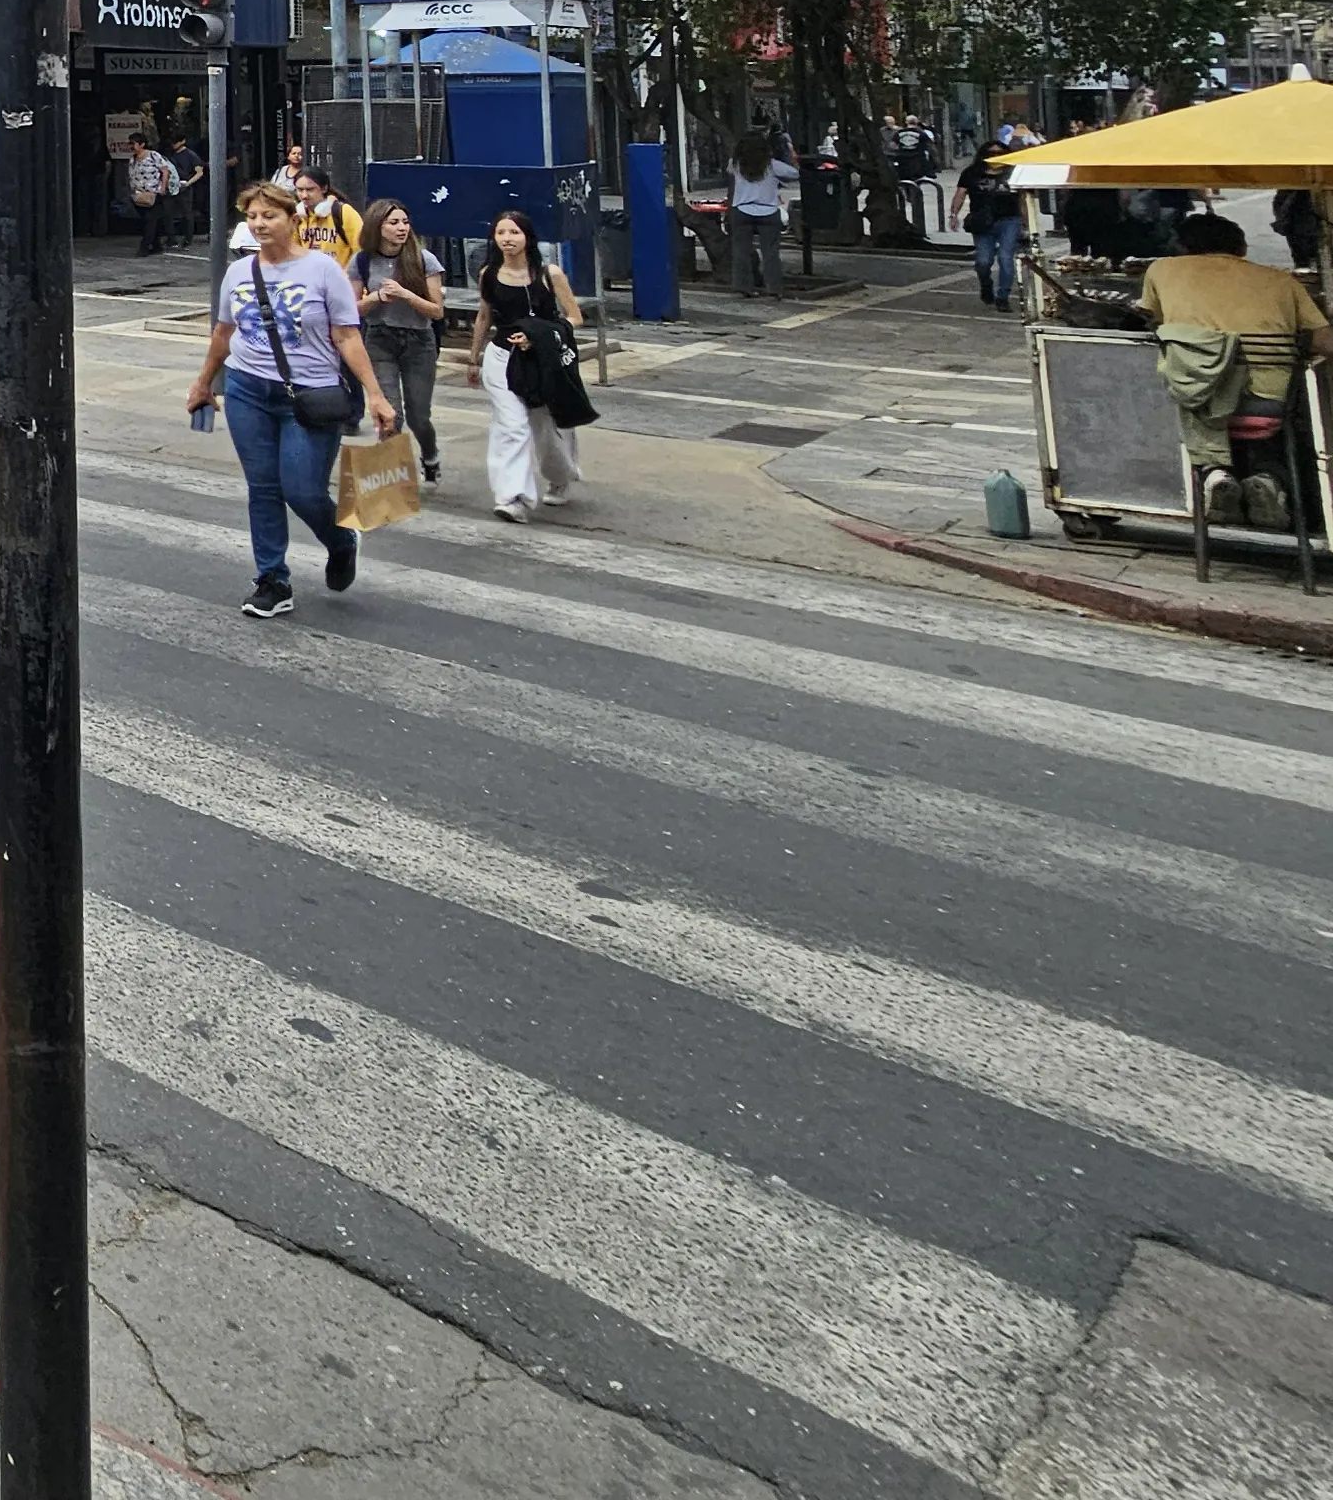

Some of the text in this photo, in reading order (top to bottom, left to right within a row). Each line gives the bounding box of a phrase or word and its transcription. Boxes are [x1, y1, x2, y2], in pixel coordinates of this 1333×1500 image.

[440, 3, 473, 15] CCC
[109, 57, 169, 70] SUNSET
[359, 466, 409, 495] INDIAN
